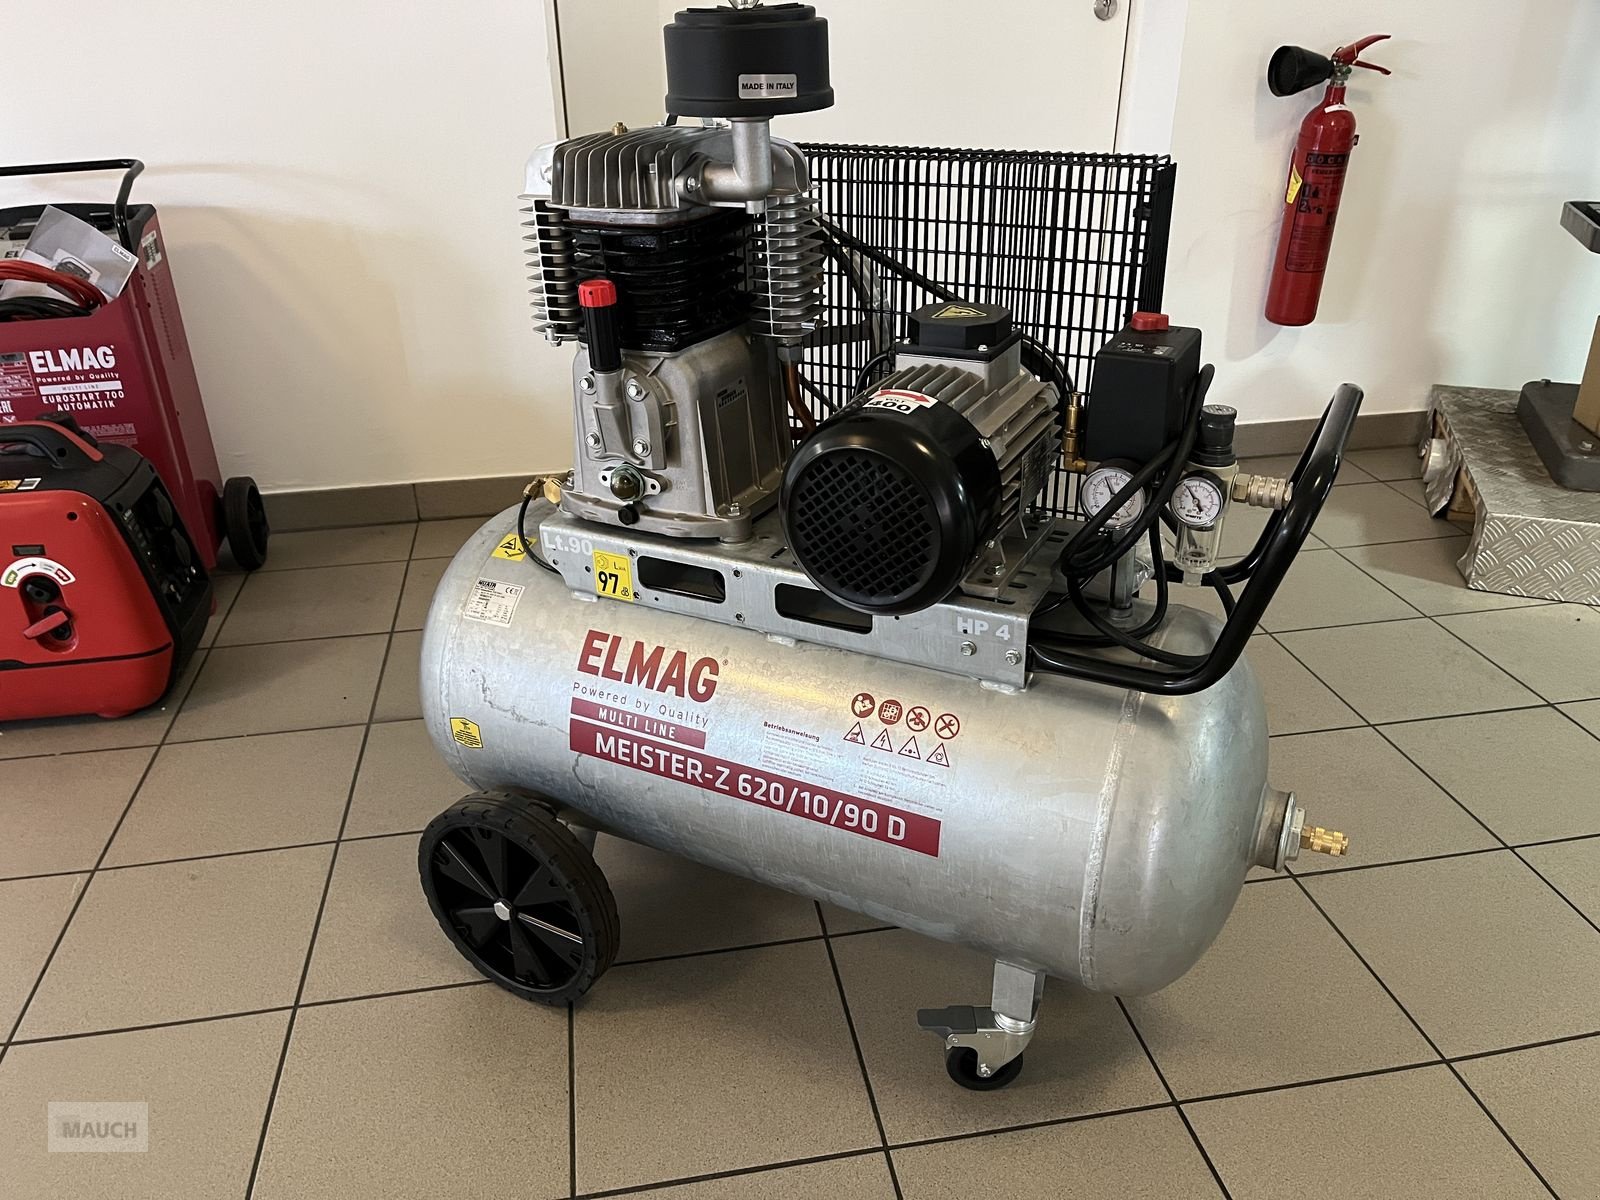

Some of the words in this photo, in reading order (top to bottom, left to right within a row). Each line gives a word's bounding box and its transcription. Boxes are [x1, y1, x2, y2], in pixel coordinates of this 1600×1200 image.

[742, 82, 764, 90] MADE
[766, 82, 775, 90] IN
[776, 81, 795, 90] ITALY
[36, 375, 71, 383] Powered
[75, 374, 85, 382] by
[89, 372, 119, 381] Quality
[42, 391, 100, 404] EUROSTART
[104, 390, 125, 399] 700
[57, 400, 116, 412] AUTOMATIK
[867, 400, 912, 411] 400
[543, 531, 593, 556] Lt.90
[598, 571, 619, 594] 97
[957, 616, 989, 635] HP
[995, 625, 1011, 641] 4
[572, 682, 627, 705] Powered
[636, 698, 650, 712] by
[658, 704, 709, 728] Quality
[598, 707, 638, 727] MULTI
[645, 719, 676, 739] LINE
[763, 721, 820, 742] Betriebsanweisung
[595, 732, 730, 791] MEISTER-Z
[738, 773, 878, 833] 620/10/90
[887, 814, 906, 841] D
